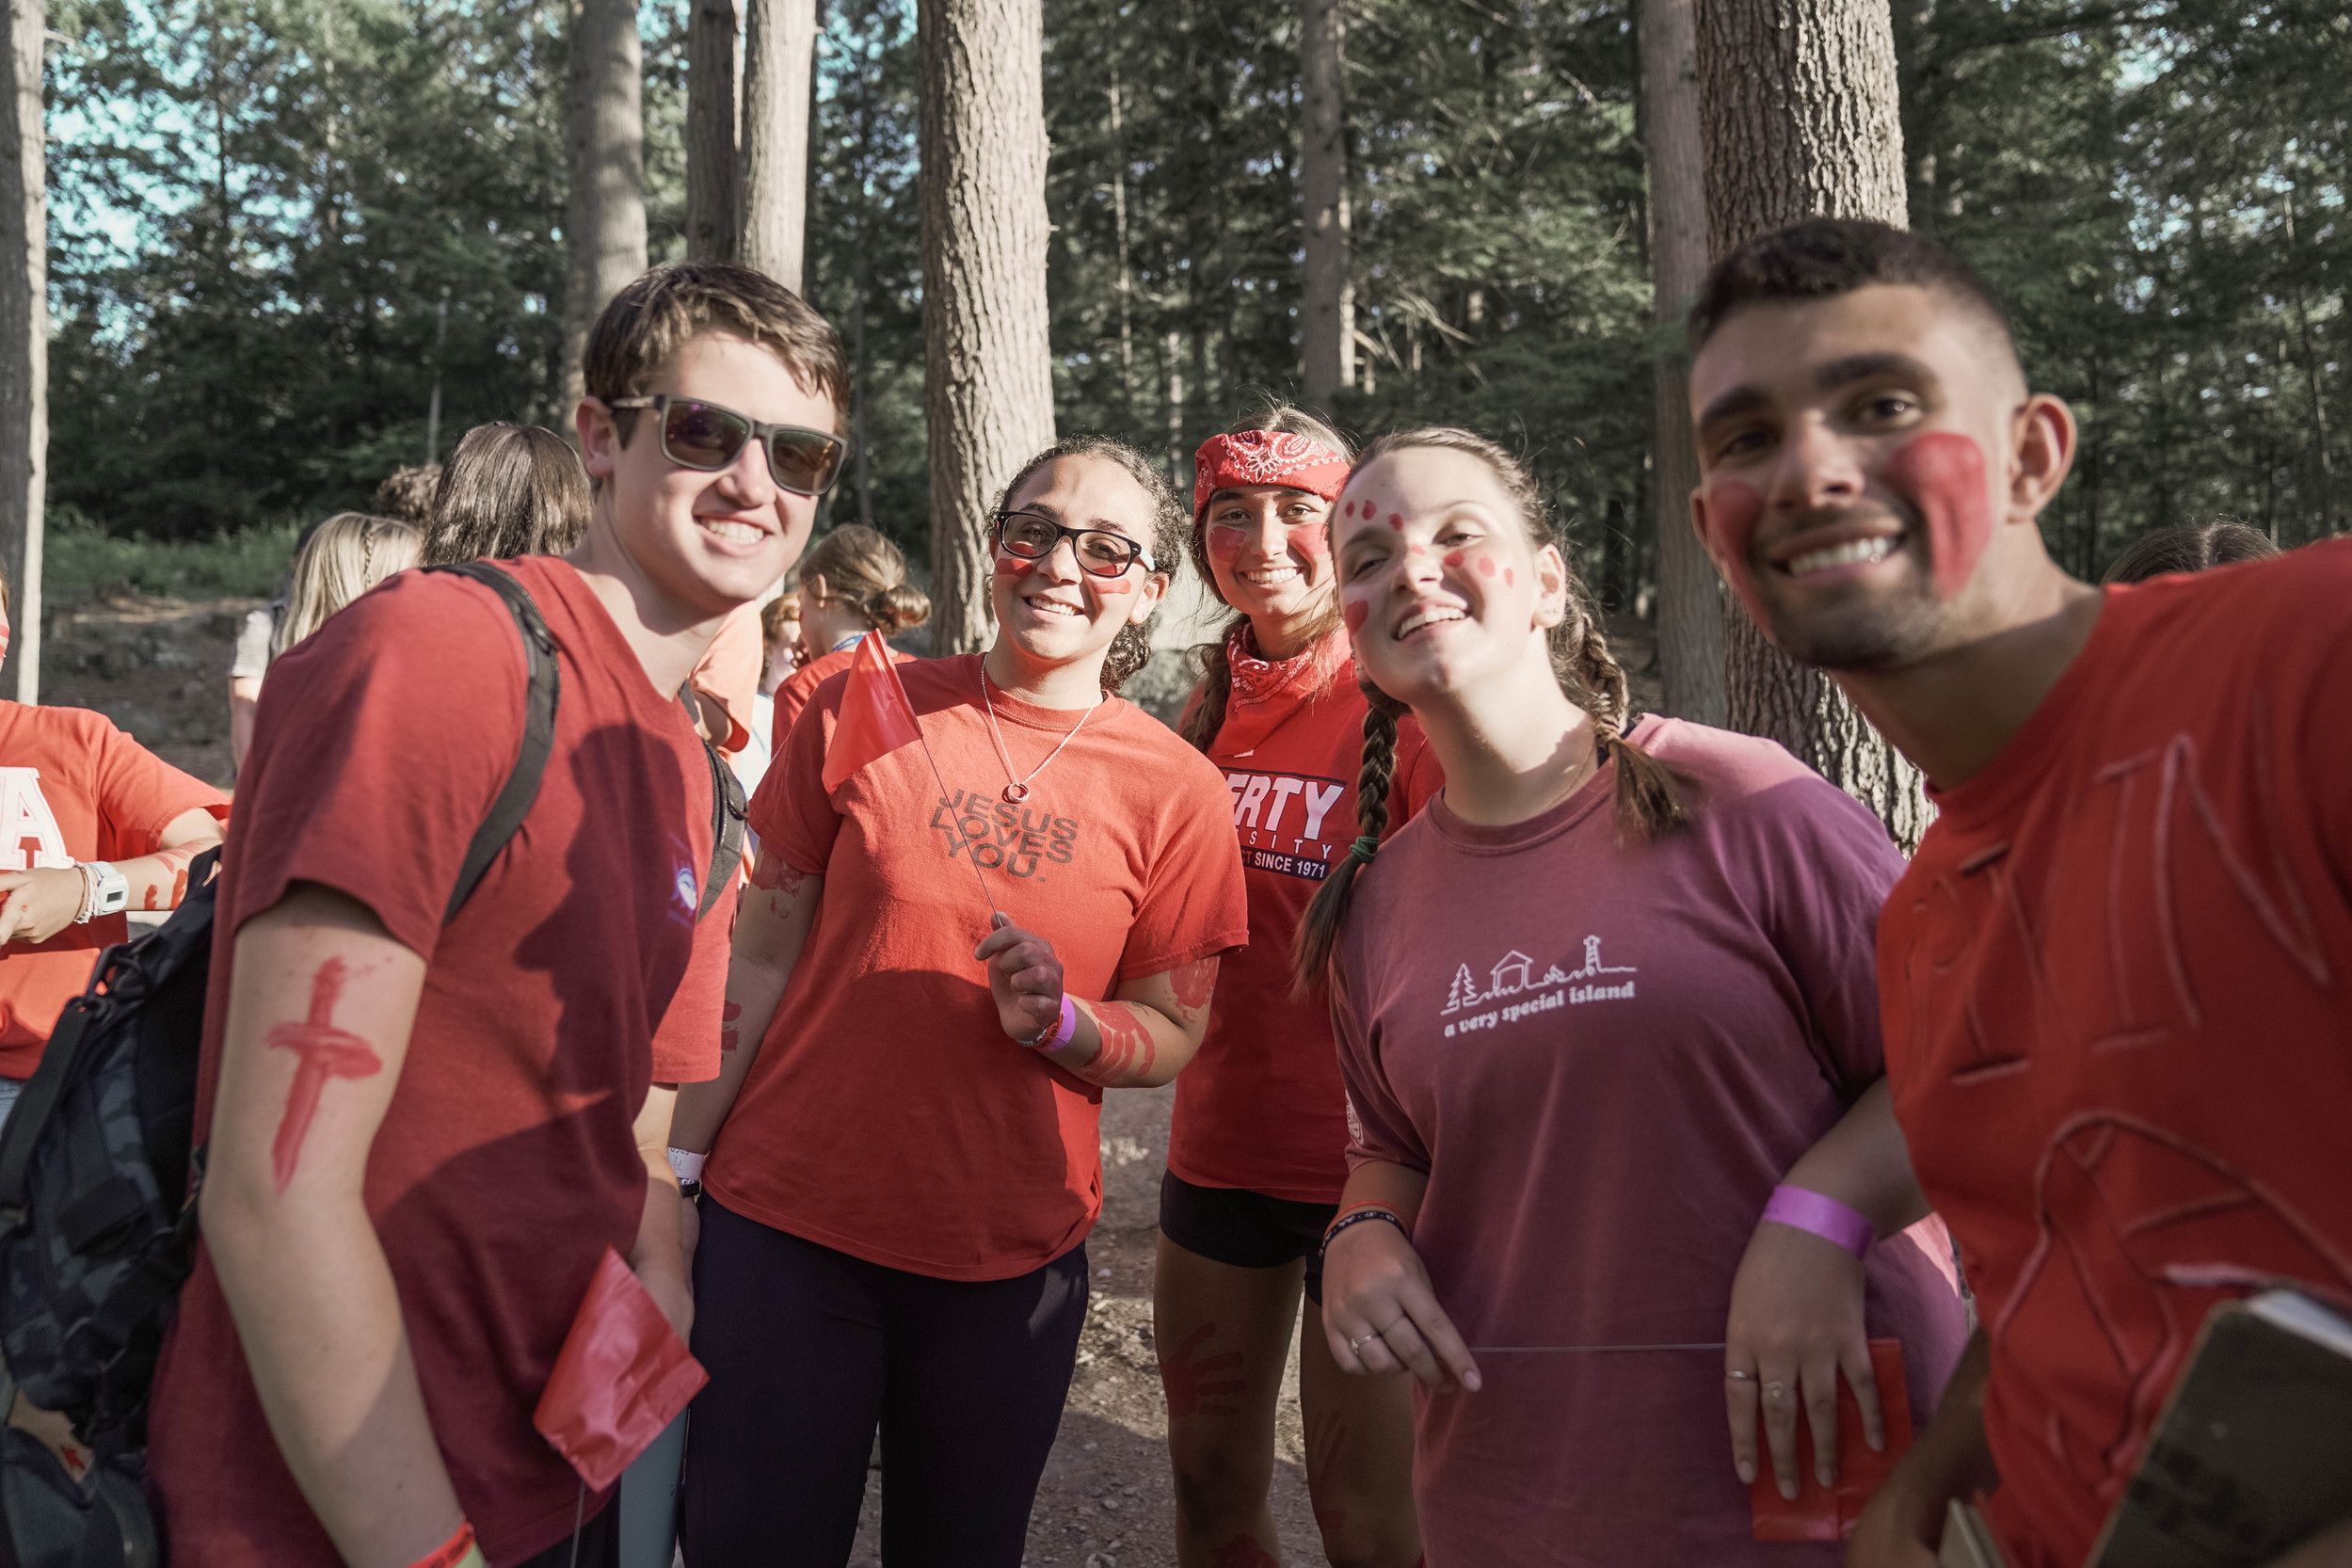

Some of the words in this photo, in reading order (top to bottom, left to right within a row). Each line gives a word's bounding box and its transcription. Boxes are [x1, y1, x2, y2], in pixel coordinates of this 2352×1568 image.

[930, 806, 1074, 863] LOVES
[938, 789, 1079, 841] JESUS
[944, 830, 1047, 883] YOU.
[1235, 829, 1332, 859] SITY
[1255, 851, 1292, 872] SINCE
[1297, 860, 1326, 878] 1971
[1444, 1023, 1456, 1038] a
[1458, 1010, 1498, 1033] very
[1501, 989, 1565, 1022] special
[1569, 981, 1636, 1004] island
